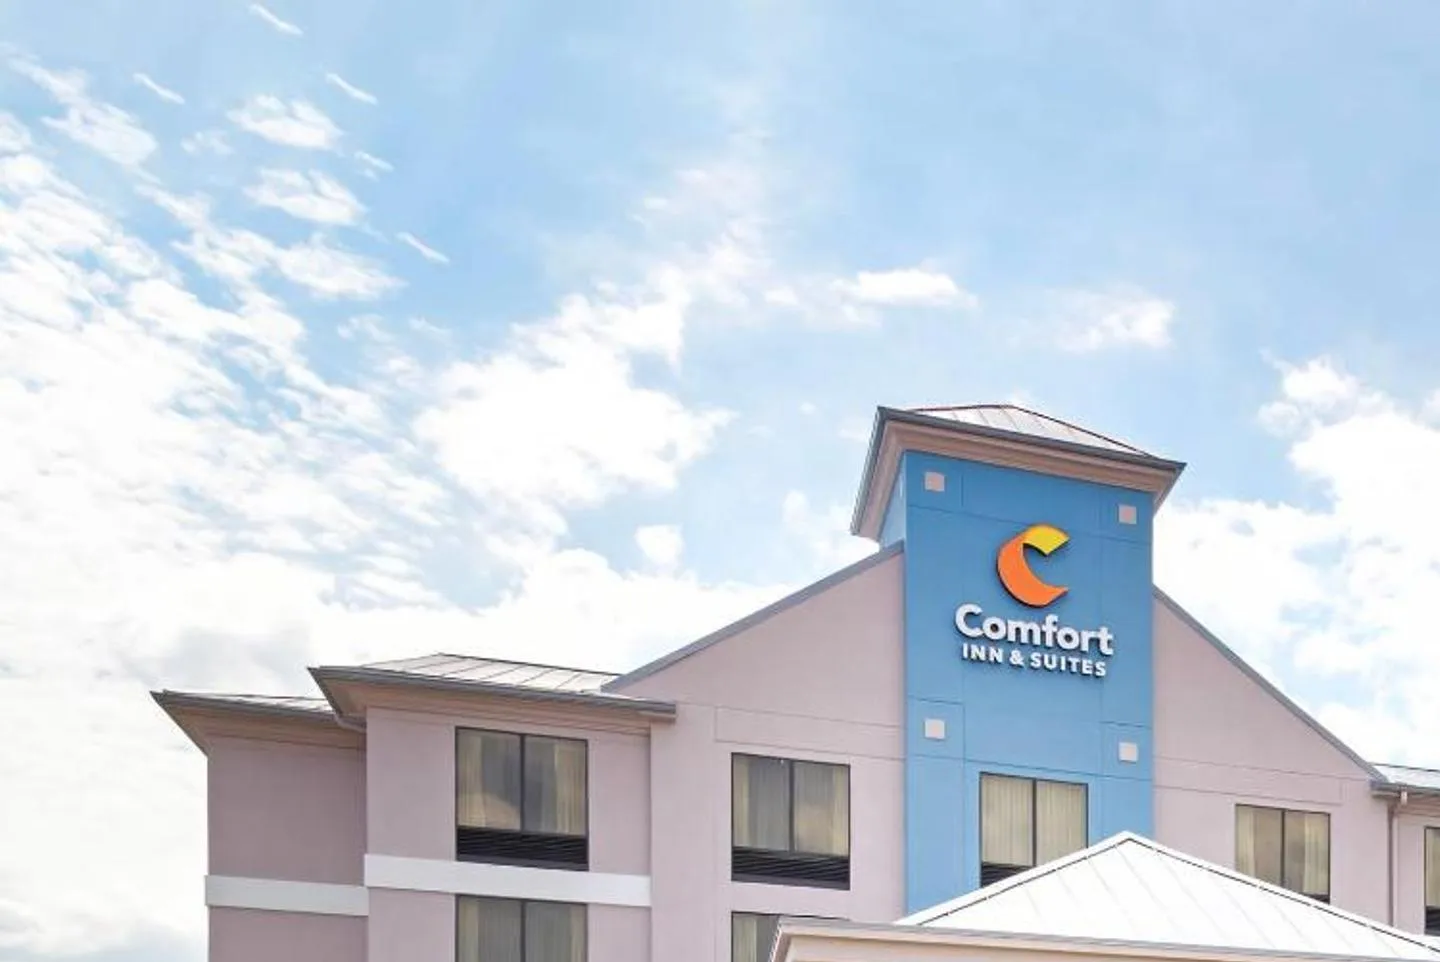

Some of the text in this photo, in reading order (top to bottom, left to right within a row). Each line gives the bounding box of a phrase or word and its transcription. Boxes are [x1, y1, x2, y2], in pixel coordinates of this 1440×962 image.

[955, 603, 1113, 655] Comfort
[962, 643, 1106, 676] INN & SUITES
